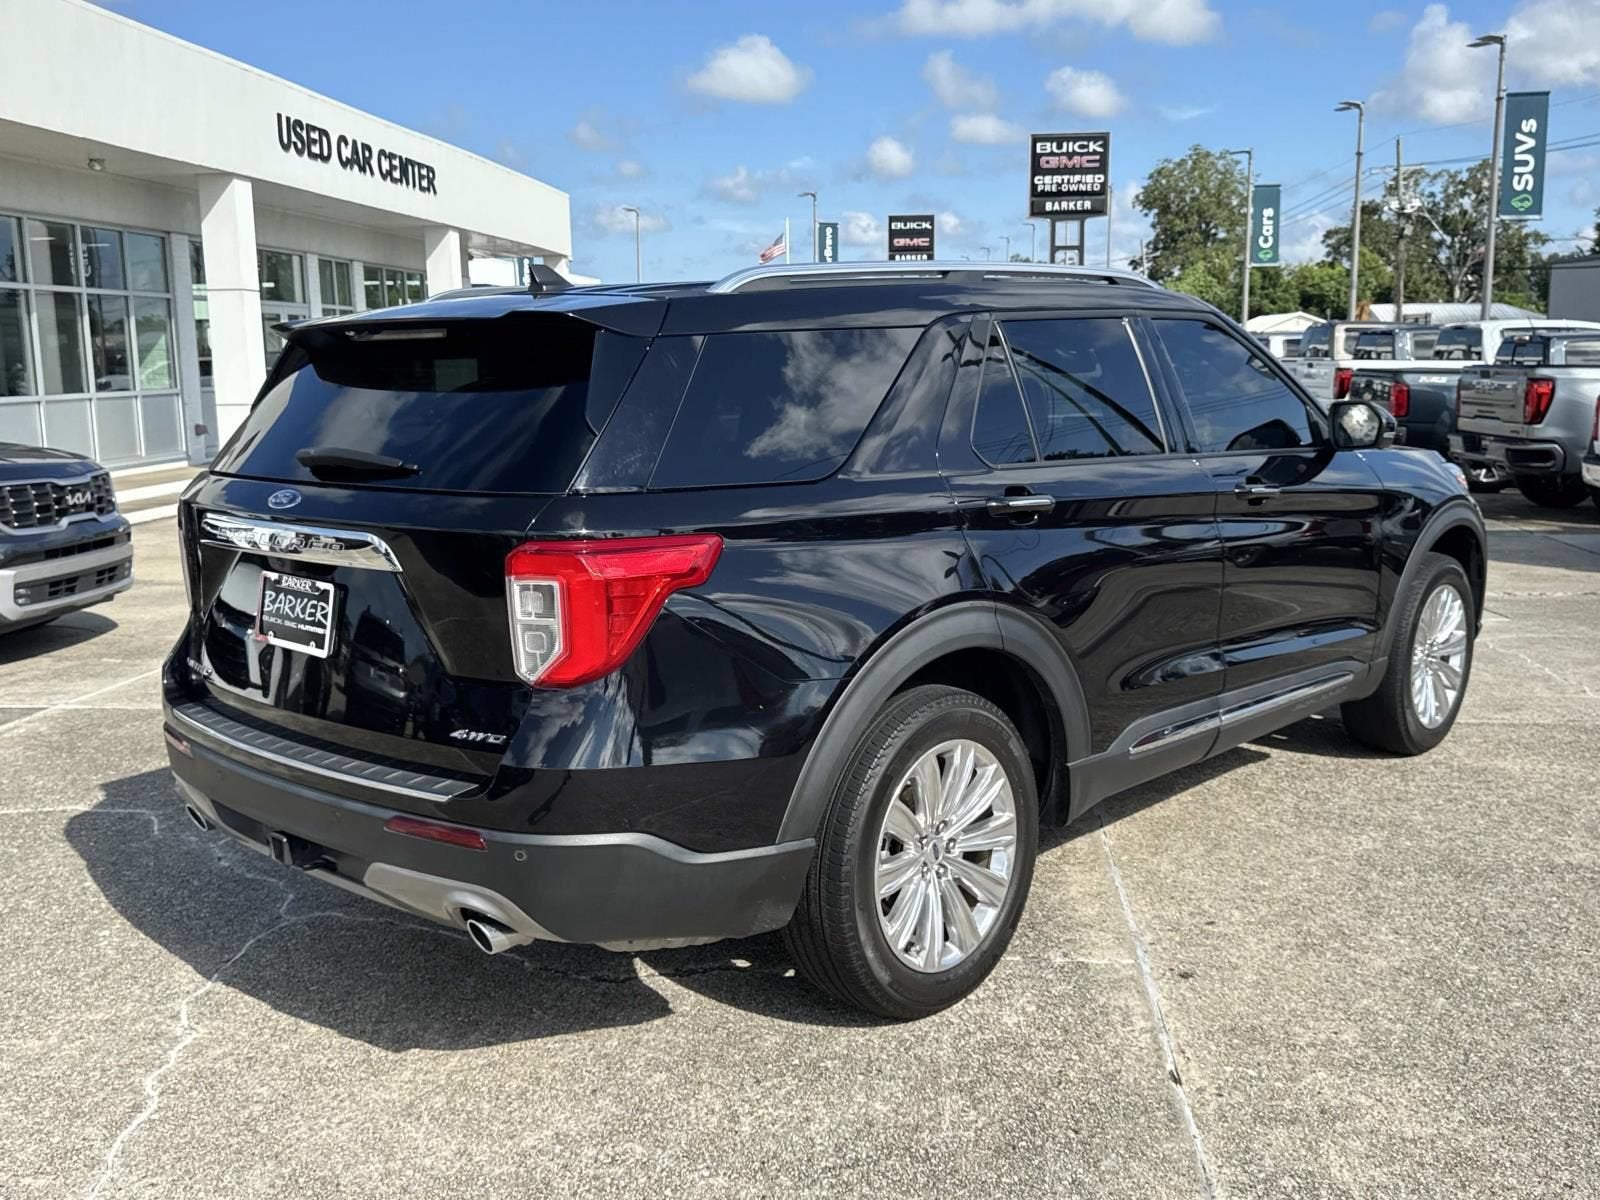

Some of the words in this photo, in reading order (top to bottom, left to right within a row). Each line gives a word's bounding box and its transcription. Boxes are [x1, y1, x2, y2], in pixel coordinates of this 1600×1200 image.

[276, 112, 332, 164] USED
[336, 134, 375, 177] CAR
[377, 148, 438, 196] CENTER
[1035, 140, 1105, 154] BUICK
[1039, 155, 1101, 169] GMC
[1512, 118, 1538, 192] SUVs
[1033, 174, 1105, 185] CERTIFIED
[1037, 183, 1101, 193] PRE-OWNED
[1045, 200, 1092, 212] BARKER
[891, 221, 932, 230] BUICK
[1258, 207, 1274, 249] Cars
[893, 237, 930, 247] GMC
[282, 575, 312, 593] BARKER
[263, 590, 329, 625] BARKER
[449, 729, 507, 744] 4WD
